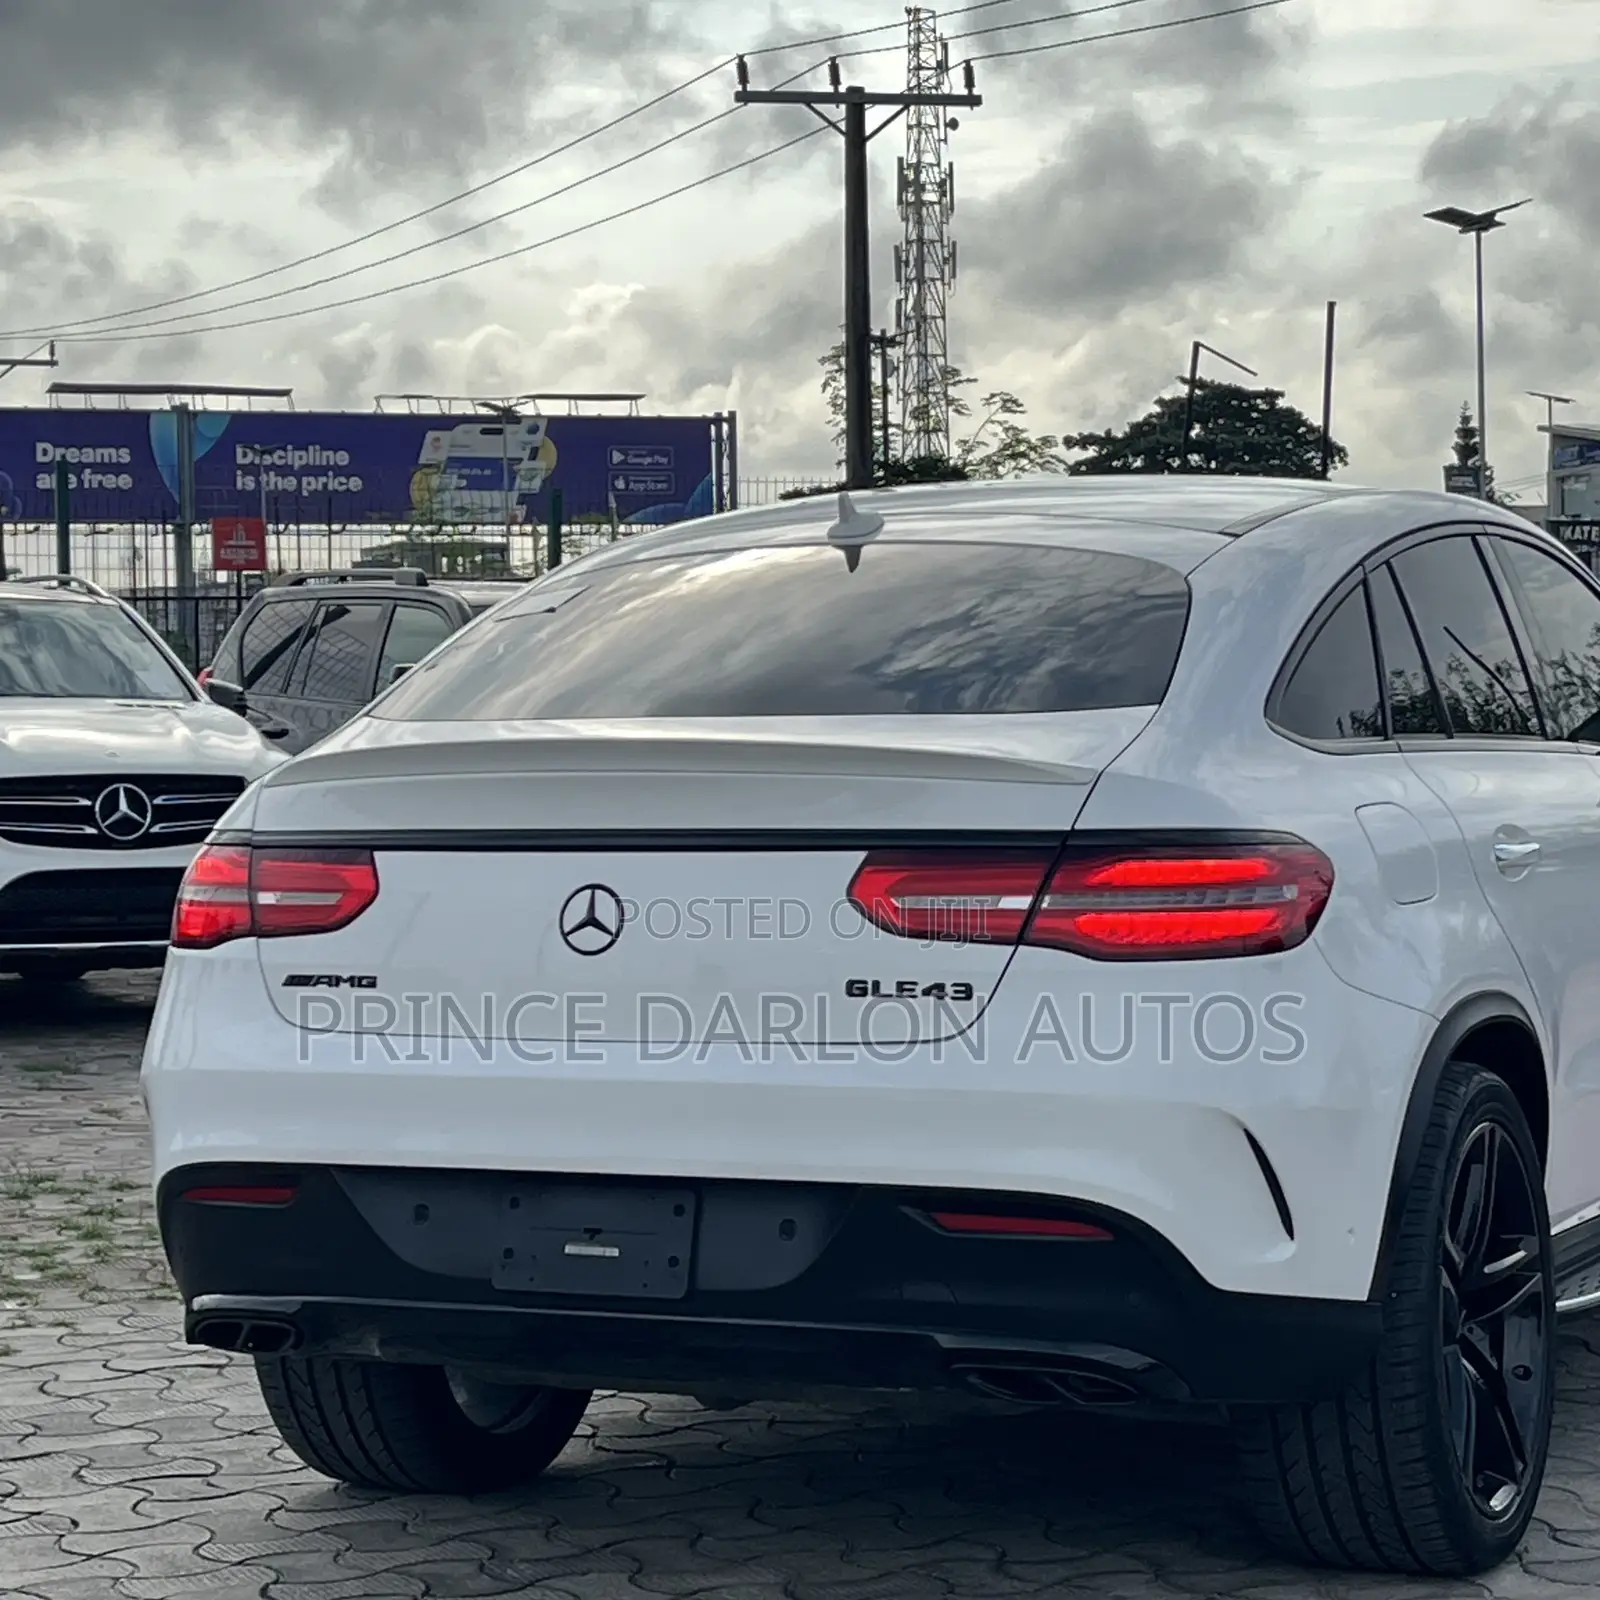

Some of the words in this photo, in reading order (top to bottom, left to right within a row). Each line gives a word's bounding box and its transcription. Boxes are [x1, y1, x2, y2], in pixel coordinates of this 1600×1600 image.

[35, 441, 132, 464] Dreams
[235, 443, 350, 471] Discipline
[81, 468, 133, 490] free
[235, 469, 256, 491] is
[259, 471, 298, 492] the
[301, 470, 363, 497] price
[309, 974, 378, 989] AMG
[844, 977, 975, 1001] GLE43
